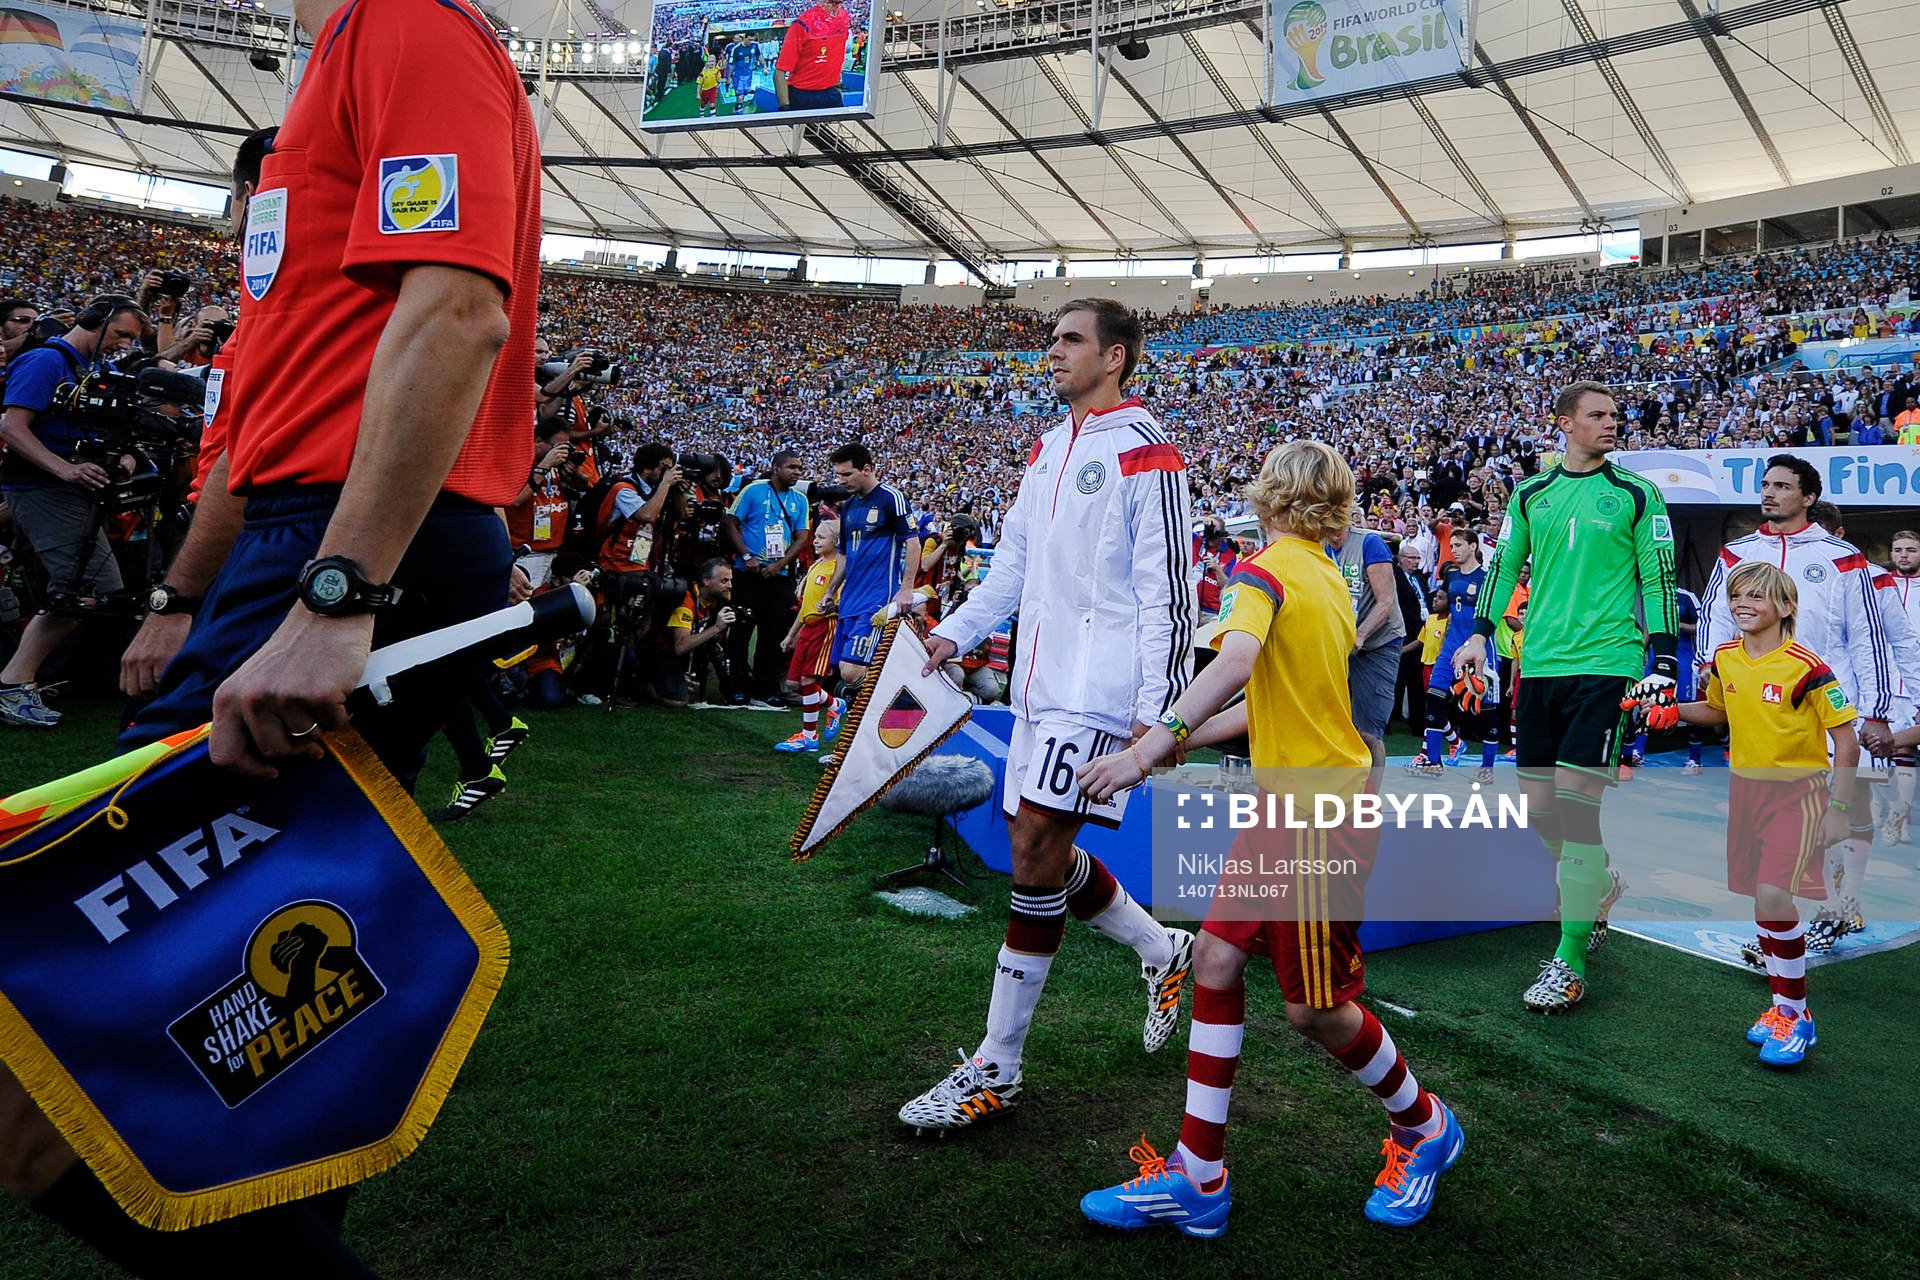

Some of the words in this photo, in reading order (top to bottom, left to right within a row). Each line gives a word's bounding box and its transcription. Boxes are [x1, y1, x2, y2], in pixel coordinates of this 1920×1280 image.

[1308, 22, 1328, 40] 2014
[1333, 14, 1362, 31] FIFA
[1365, 1, 1417, 23] WORLD
[1420, 0, 1446, 10] CU
[1330, 12, 1448, 70] Brasil
[1880, 186, 1894, 196] 02
[430, 219, 454, 228] FIFA
[1668, 224, 1679, 233] 03
[247, 230, 278, 258] FIFA
[251, 279, 267, 292] 2014
[1829, 455, 1920, 494] Fin
[1568, 517, 1576, 551] 1
[1455, 595, 1462, 612] 6
[850, 634, 869, 658] 10
[1601, 728, 1612, 764] 1
[1037, 736, 1080, 796] 16
[73, 812, 282, 944] FIFA
[209, 981, 258, 1028] HAND
[204, 997, 278, 1064] SHAKE
[227, 1051, 246, 1073] for
[245, 968, 365, 1077] PEACE
